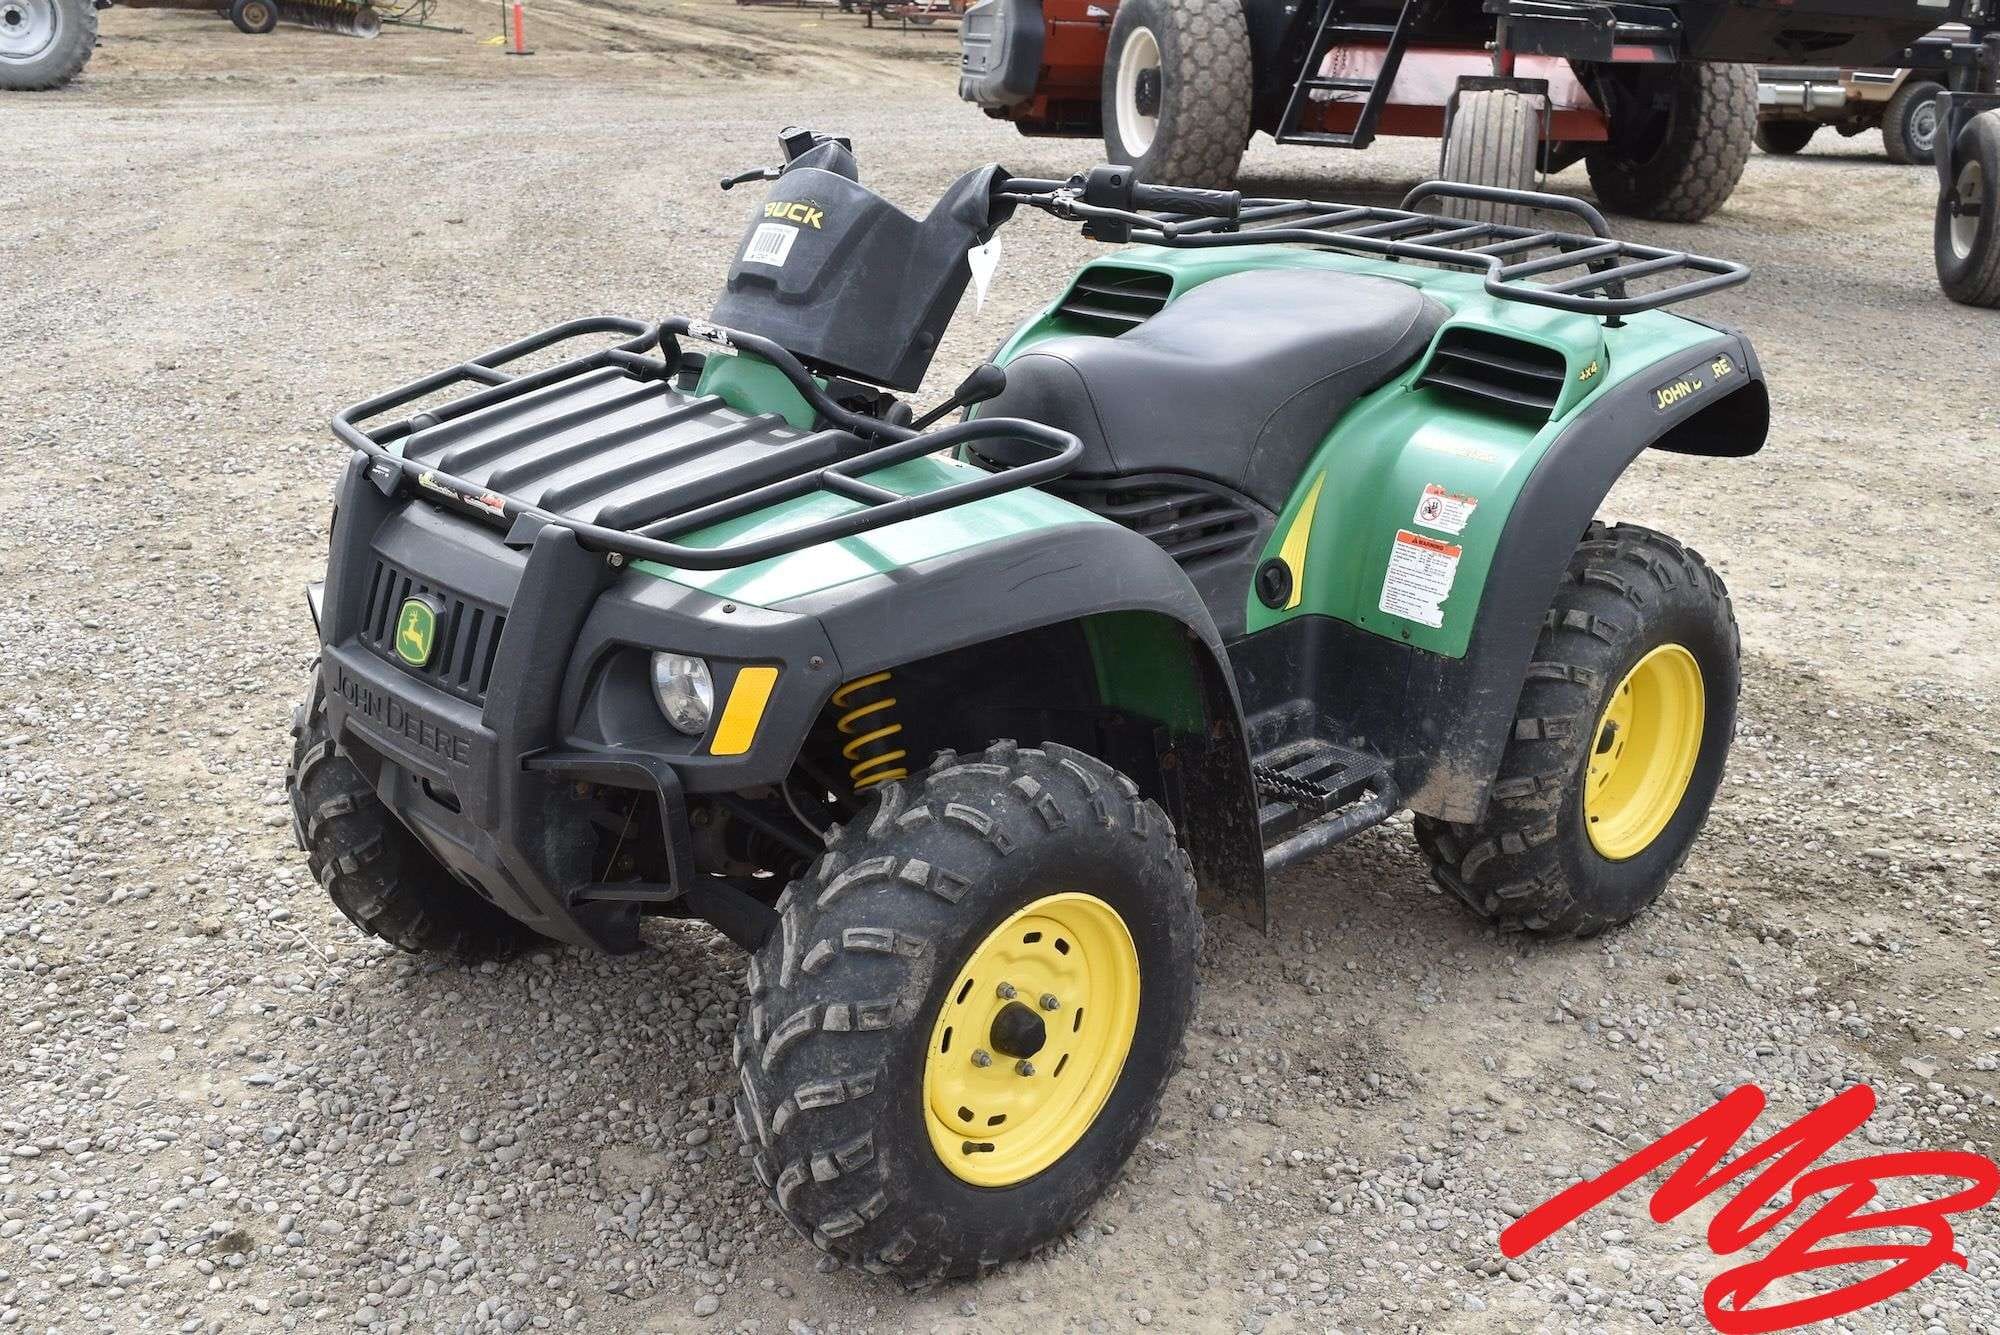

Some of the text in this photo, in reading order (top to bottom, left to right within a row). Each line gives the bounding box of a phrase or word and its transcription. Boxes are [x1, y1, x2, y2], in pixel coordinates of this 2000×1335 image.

[764, 202, 824, 229] BUCK
[1656, 381, 1692, 409] JOHN
[1418, 540, 1444, 551] WARNING
[333, 666, 472, 768] JOHN DEERE
